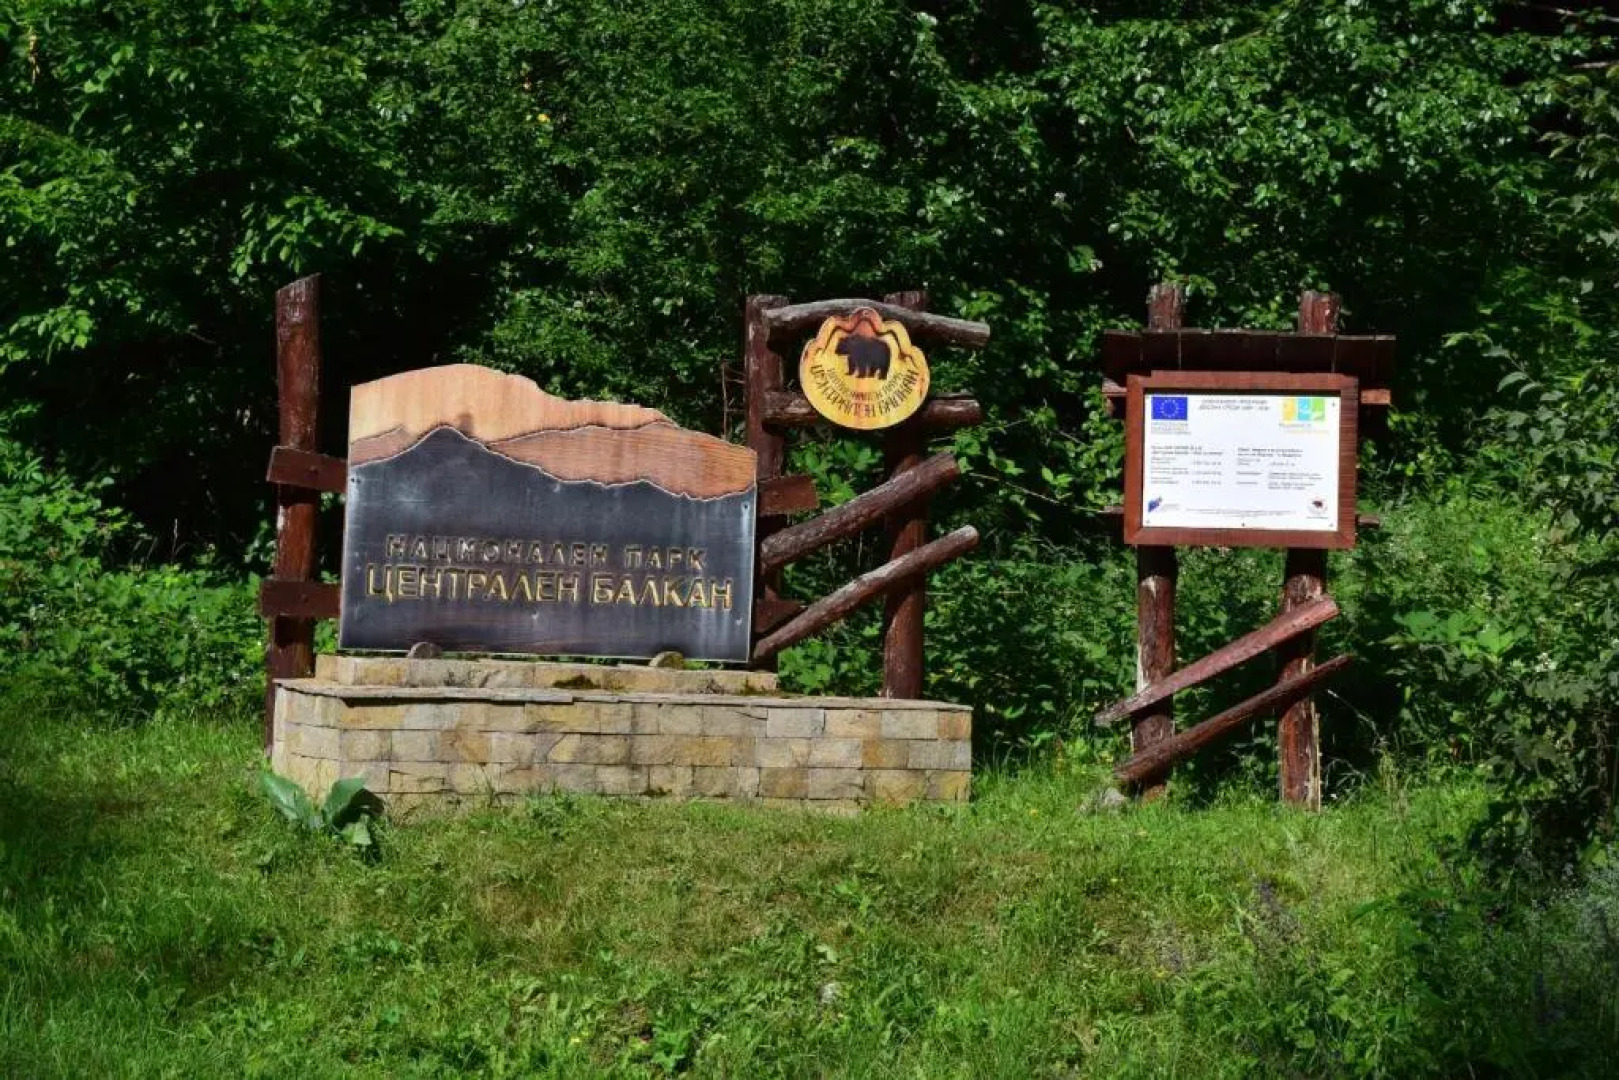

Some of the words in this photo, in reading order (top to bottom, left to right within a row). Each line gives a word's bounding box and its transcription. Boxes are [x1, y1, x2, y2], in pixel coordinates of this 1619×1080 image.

[385, 534, 608, 567] НАЦИОНАЛЕН
[623, 544, 706, 570] ПАРК
[366, 563, 579, 603] ЦЕНТРАЛЕН
[591, 571, 733, 608] БАЛКАН
